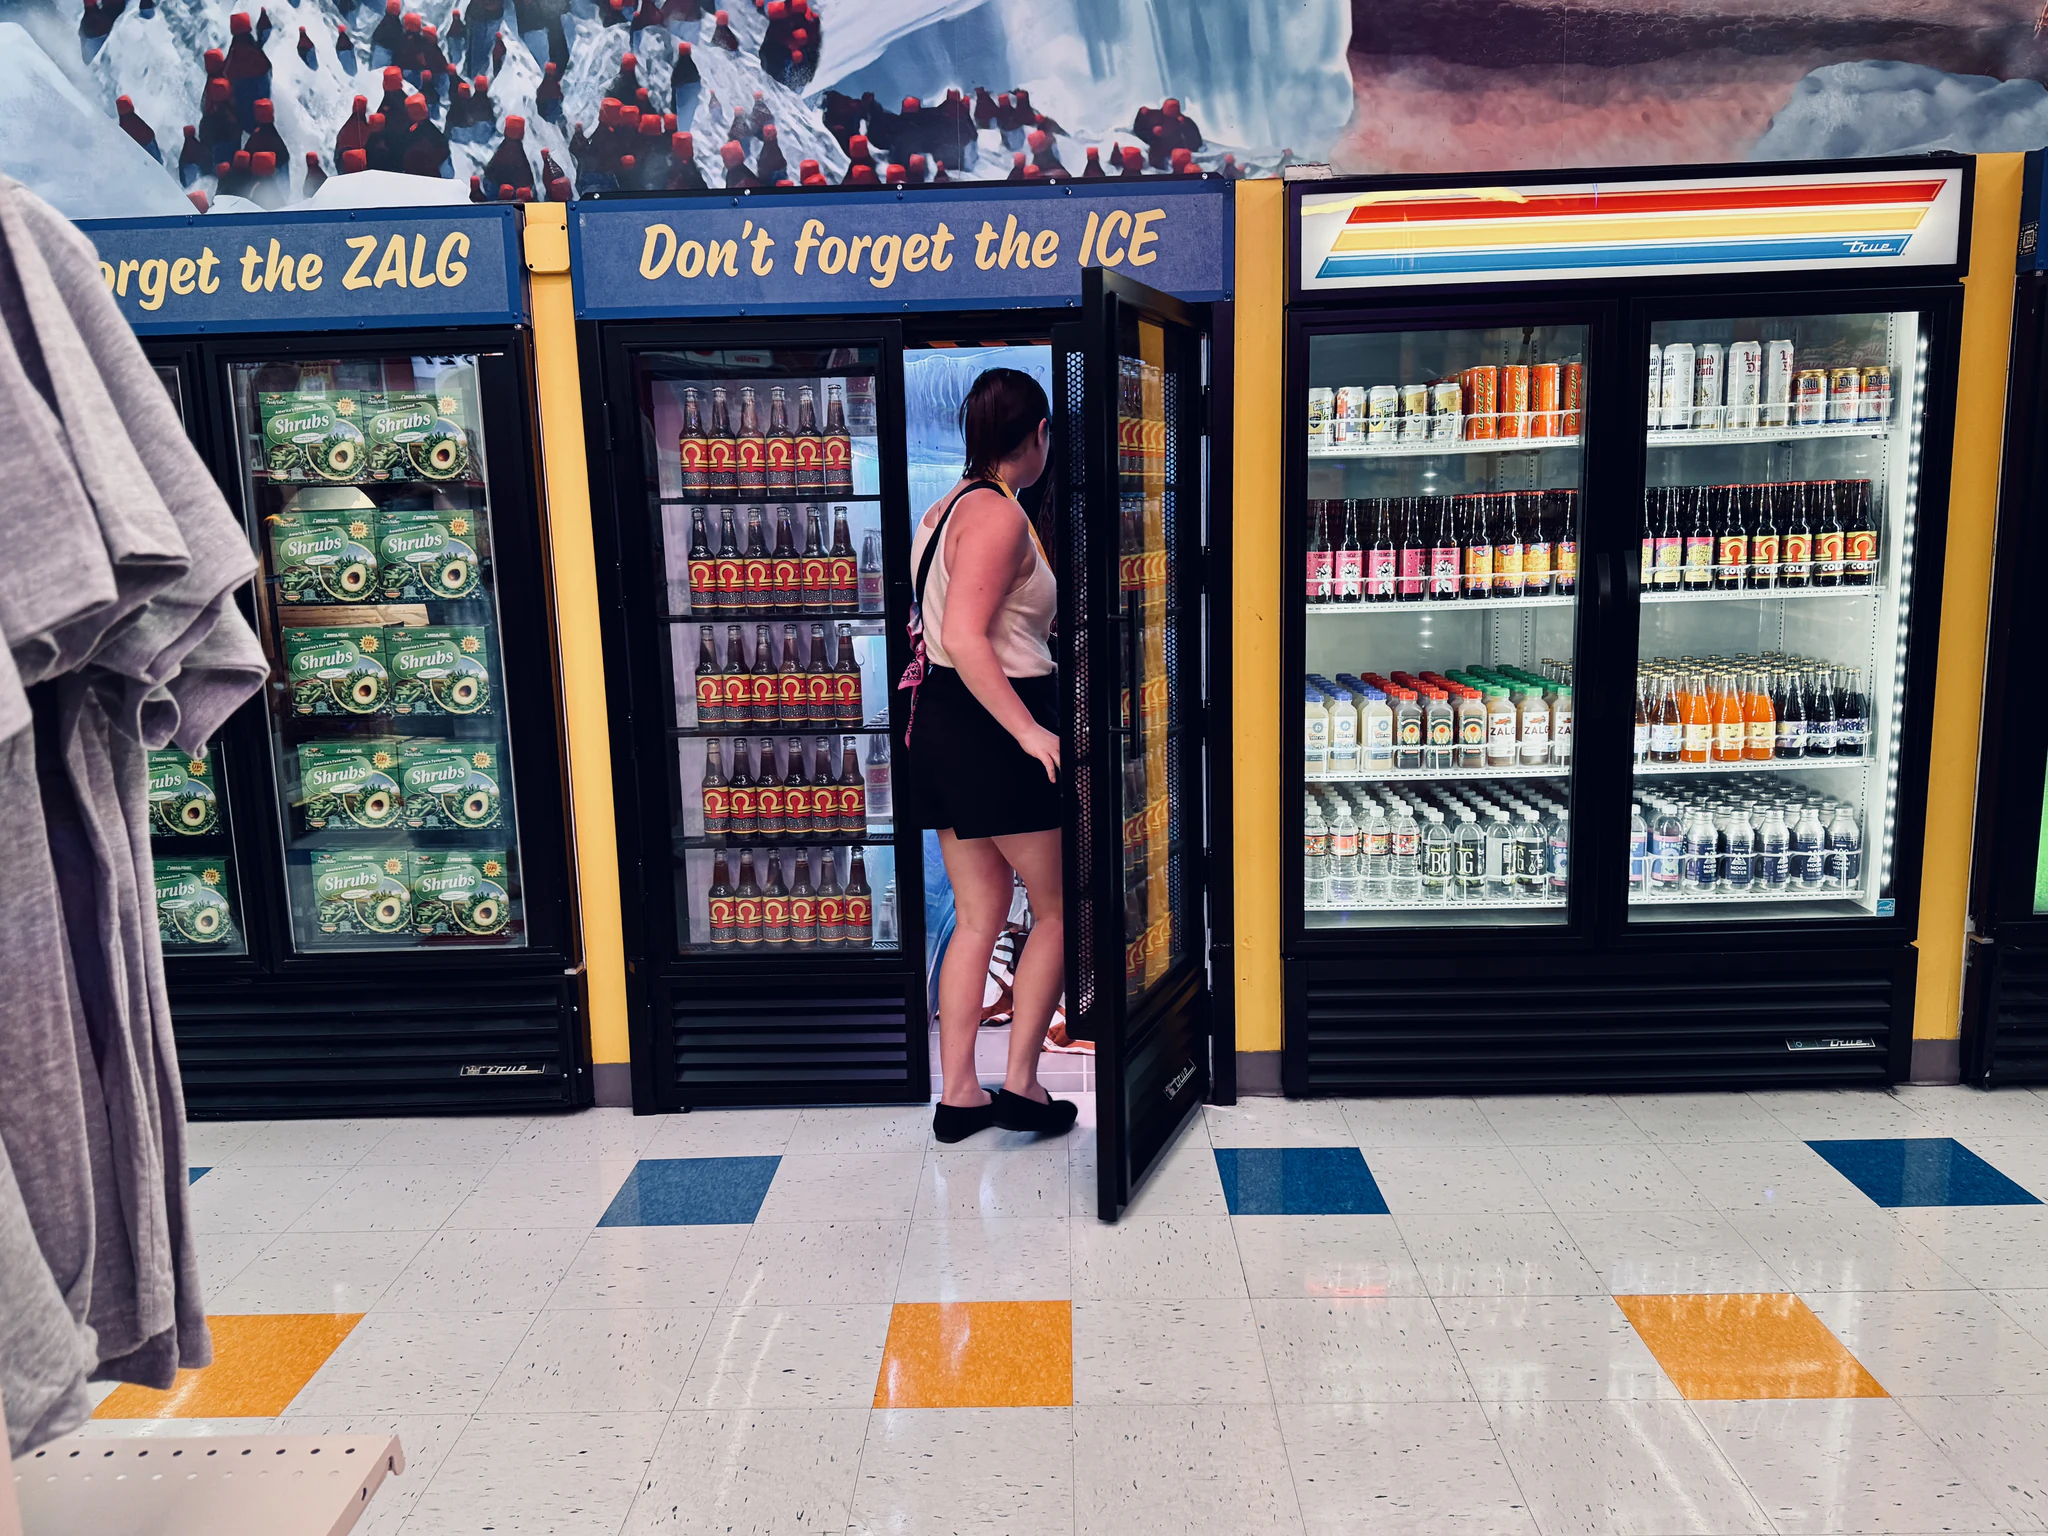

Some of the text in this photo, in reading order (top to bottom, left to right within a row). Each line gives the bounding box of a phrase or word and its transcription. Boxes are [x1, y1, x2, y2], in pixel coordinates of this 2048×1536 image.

[639, 208, 1167, 289] Don't forget the ICE
[97, 232, 471, 311] orget the ZALG
[275, 413, 329, 435] Shrubs
[376, 413, 431, 434] Shrubs
[288, 536, 342, 556] Shrubs
[388, 533, 442, 553] Shrubs
[1784, 565, 1806, 574] COLA
[300, 651, 353, 670] Shrubs
[400, 651, 453, 670] Shrubs
[1557, 726, 1571, 734] ZA
[149, 774, 182, 789] rubs
[313, 766, 366, 785] Shrubs
[412, 766, 465, 785] Shrubs
[1430, 851, 1450, 874] BO
[1456, 851, 1473, 874] OG
[154, 882, 195, 898] hrubs
[325, 872, 377, 891] Shrubs
[422, 874, 475, 893] Shrubs
